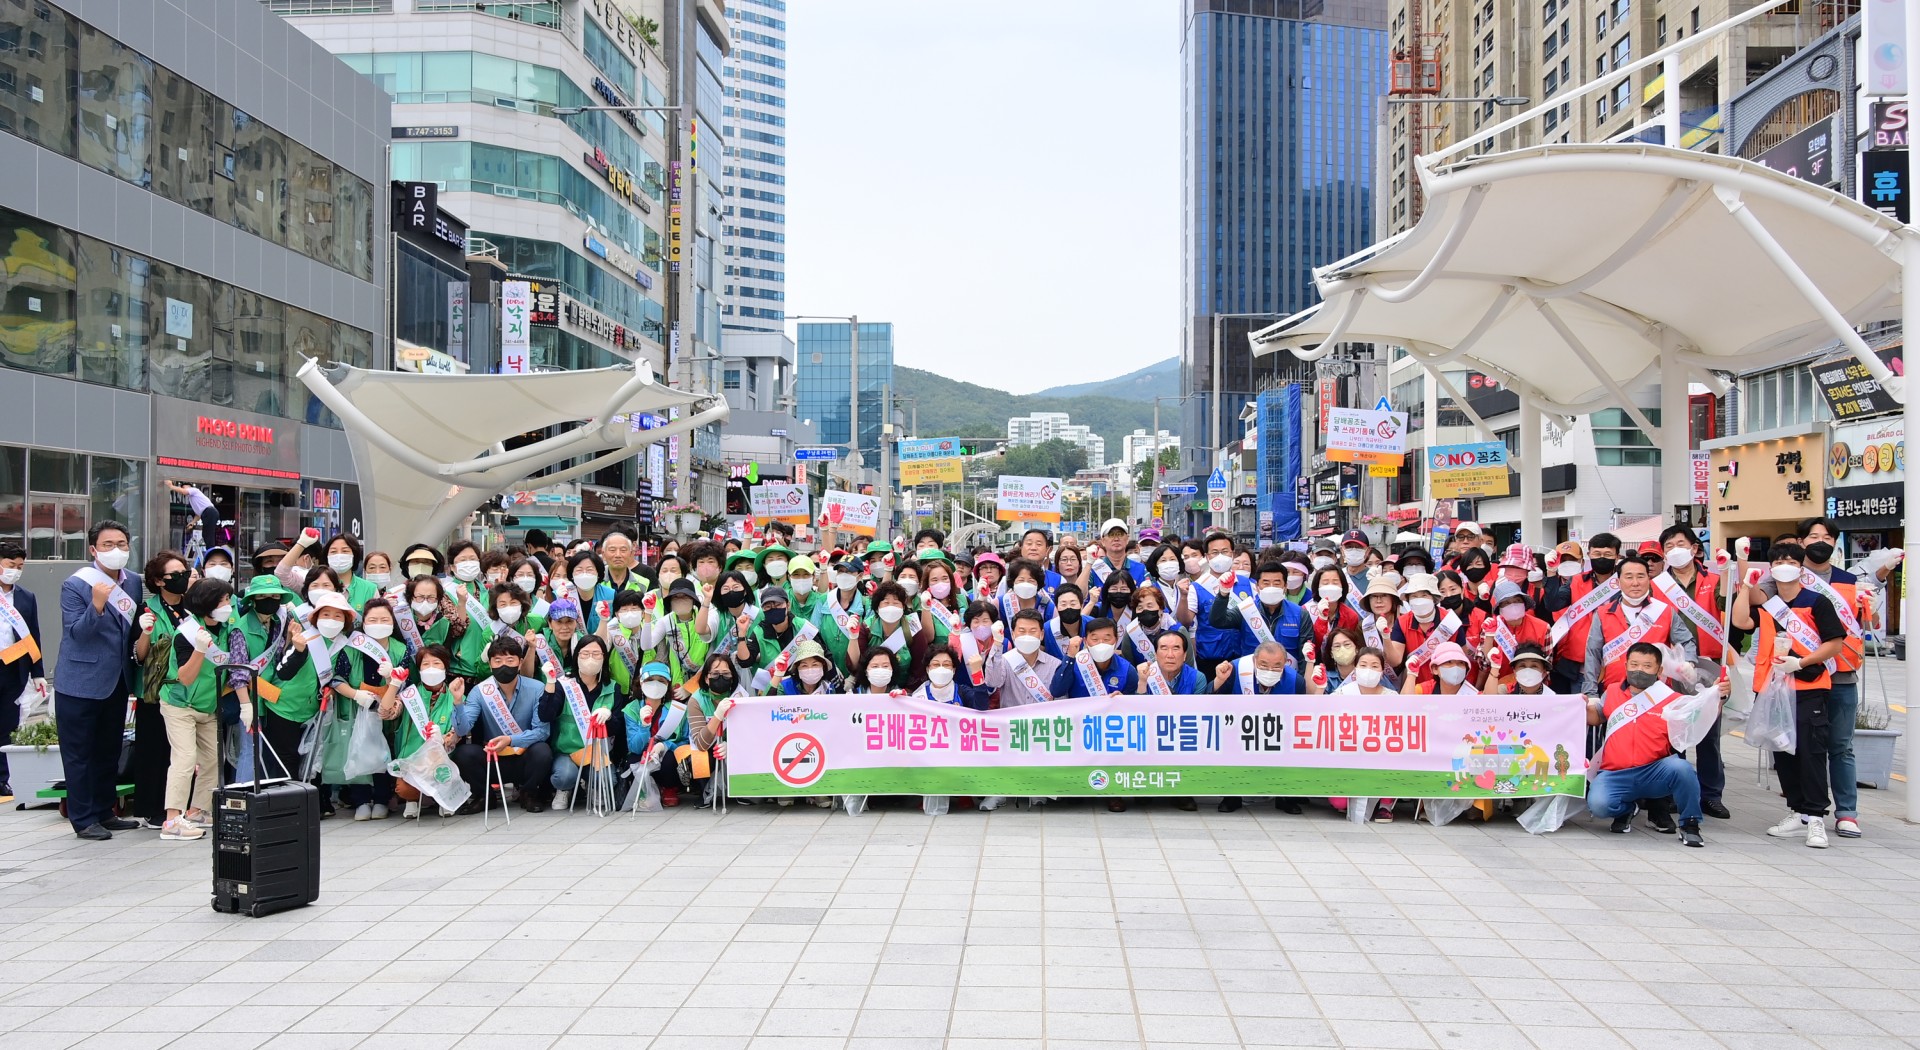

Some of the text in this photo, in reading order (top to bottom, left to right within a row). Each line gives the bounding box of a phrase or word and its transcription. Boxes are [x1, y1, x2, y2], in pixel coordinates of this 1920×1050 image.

[407, 127, 453, 136] T.747-3153
[1811, 158, 1824, 176] 3F
[413, 185, 426, 226] BAR
[197, 416, 274, 444] PHOTO DRINK
[1334, 416, 1367, 427] 담배꽁초는
[1448, 450, 1502, 466] NO 꽁초
[1694, 460, 1710, 508] 언양불고
[1837, 496, 1897, 517] 동전노래연습장
[771, 709, 829, 725] Haeundae
[959, 717, 1000, 752] 없는
[1009, 715, 1074, 752] 쾌적한
[1082, 714, 1146, 752] 해운대
[1241, 712, 1283, 752] 위한
[1293, 712, 1427, 753] 도시환경정비
[1114, 771, 1181, 789] 해운대구
